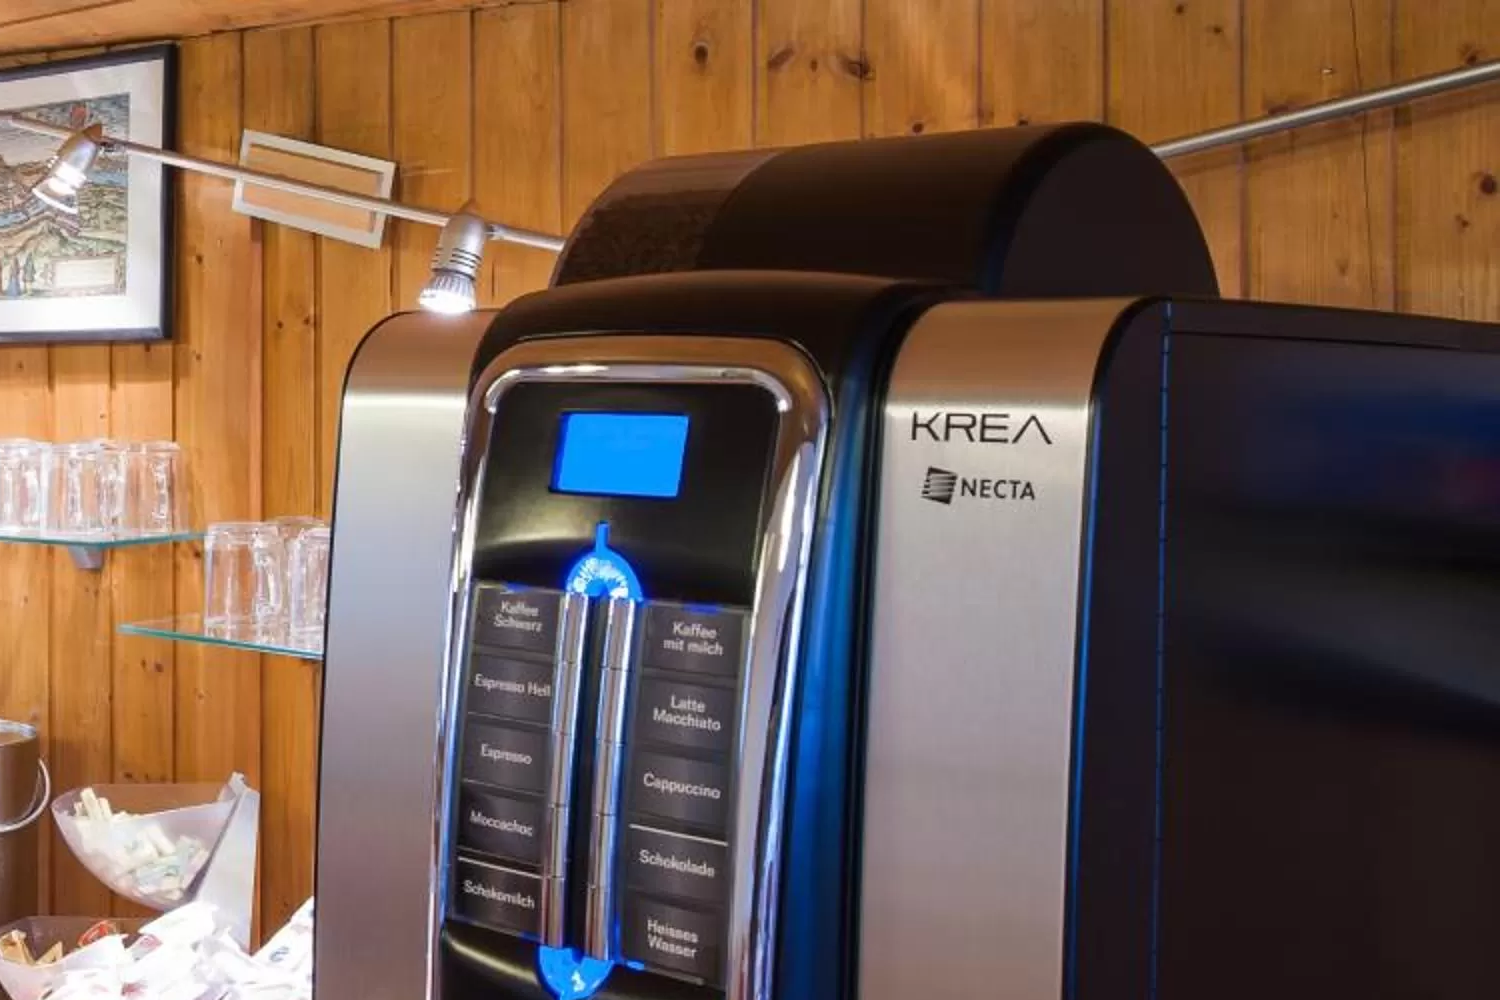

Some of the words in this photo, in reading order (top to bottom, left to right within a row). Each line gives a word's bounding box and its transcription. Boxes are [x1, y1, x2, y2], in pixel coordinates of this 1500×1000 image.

[911, 411, 1053, 445] KREA
[960, 477, 1036, 501] NECTA
[501, 600, 540, 617] Kaffee
[493, 613, 543, 632] Schwarz
[672, 621, 718, 640] Kaffee
[663, 638, 685, 652] mit
[687, 641, 724, 656] milch
[474, 673, 525, 693] Espresso
[670, 694, 706, 713] Latte
[652, 707, 722, 732] Macchiato
[480, 743, 533, 765] Espresso
[642, 772, 721, 800] Cappuccino
[638, 849, 716, 879] Schokolade
[463, 879, 536, 909] Schokomilch
[647, 919, 699, 944] Heisses
[647, 934, 698, 959] Wasser
